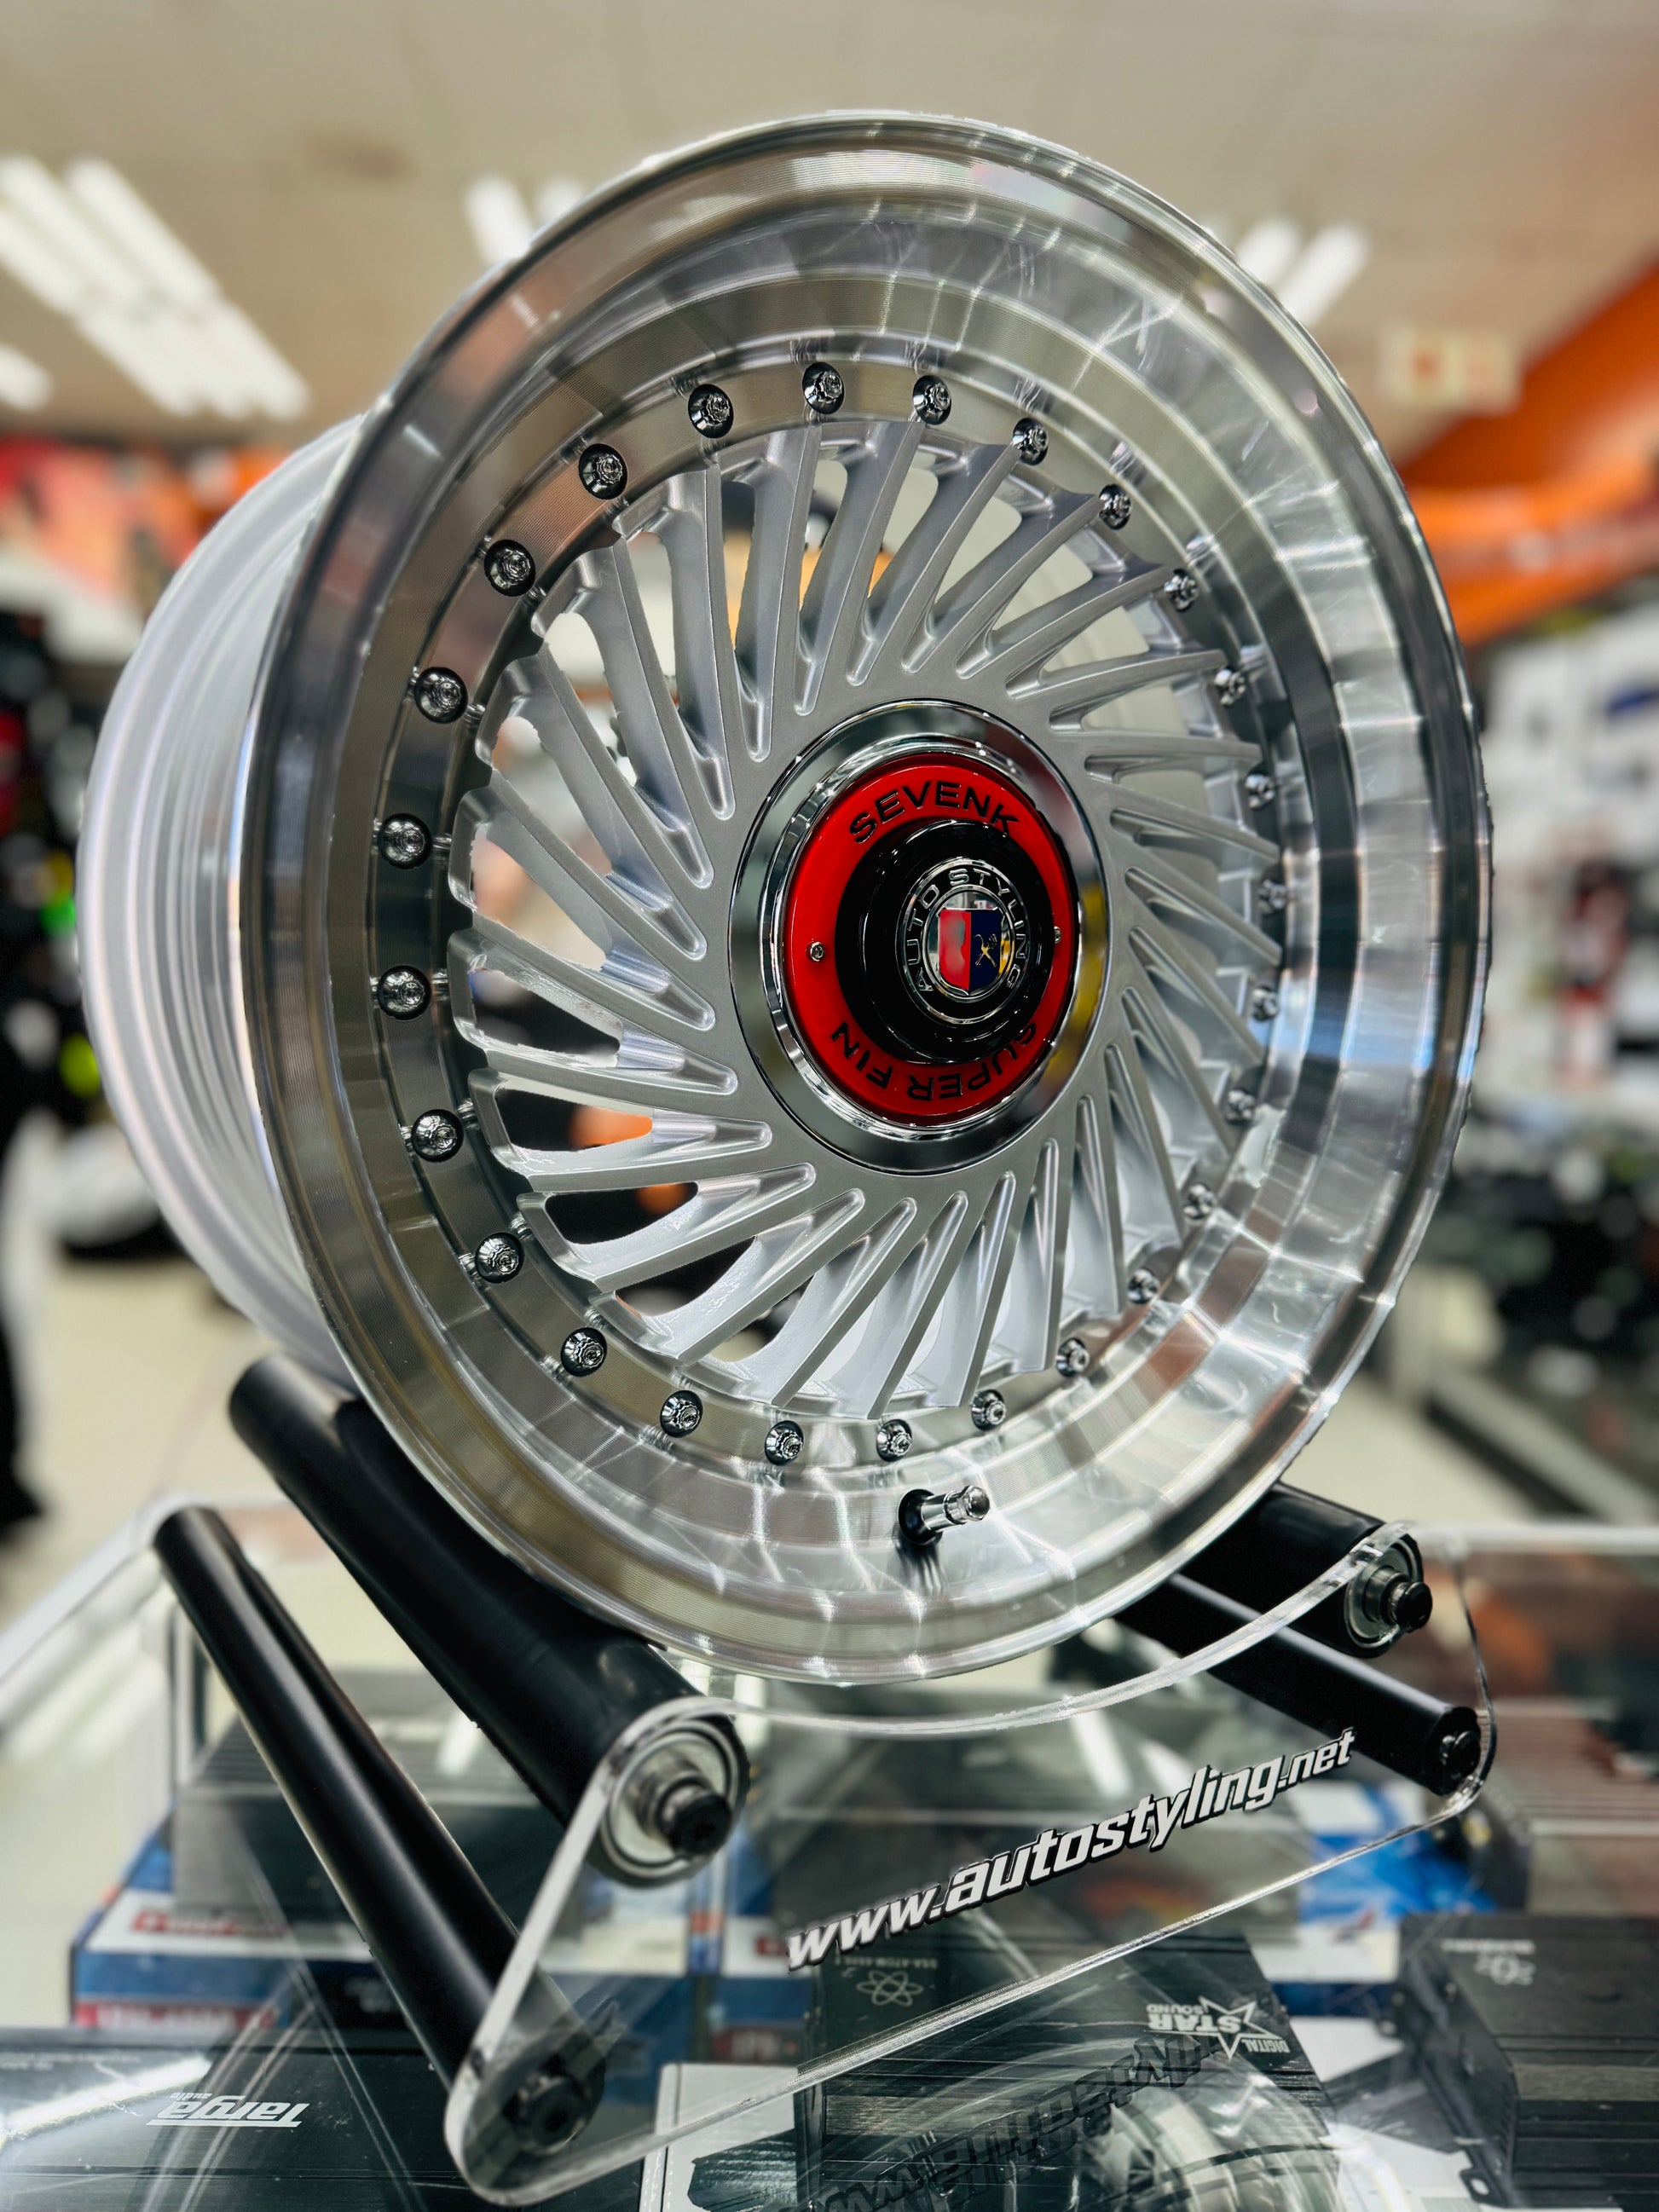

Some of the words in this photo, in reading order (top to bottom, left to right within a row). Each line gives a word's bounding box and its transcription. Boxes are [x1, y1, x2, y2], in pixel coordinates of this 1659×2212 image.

[849, 780, 1020, 844] SEVENK
[830, 1020, 893, 1089] FIN
[907, 1023, 1038, 1101] SUPER
[786, 1726, 1356, 1972] www.autostyling.net
[1146, 2003, 1205, 2016] SOUND
[1147, 2013, 1242, 2034] STAR
[1240, 2038, 1291, 2053] DIGITAL
[145, 2094, 310, 2128] Targa
[170, 2091, 213, 2101] audio
